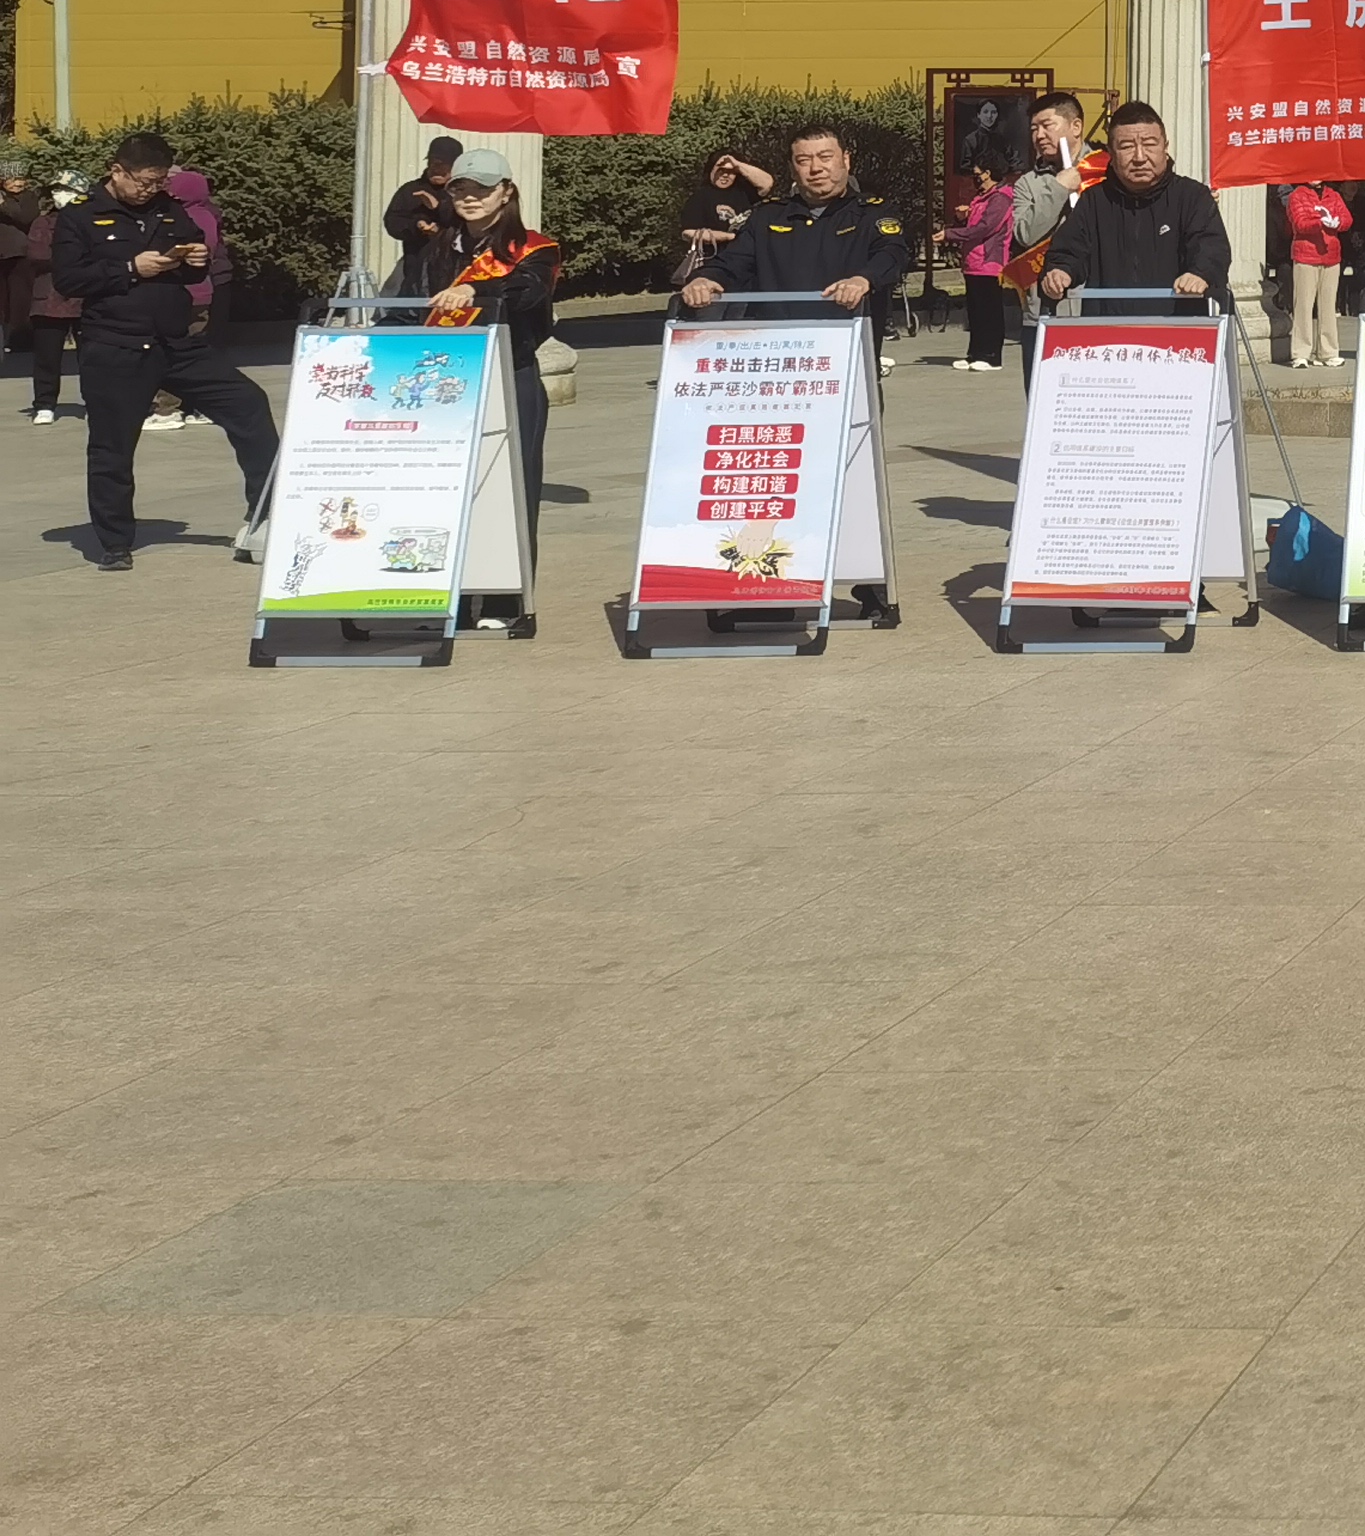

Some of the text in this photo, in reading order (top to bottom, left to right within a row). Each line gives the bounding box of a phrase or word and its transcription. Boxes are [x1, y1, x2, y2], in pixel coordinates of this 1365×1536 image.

[406, 35, 641, 79] 兴安盟自然资源局 宣
[400, 61, 611, 90] 乌兰浩特市自然资源局
[1053, 346, 1208, 364] 加强社会信用体系建设
[694, 356, 832, 374] 重拳出击扫黑除恶
[674, 379, 841, 398] 依法严惩沙霸矿霸犯罪
[718, 426, 794, 445] 扫黑除恶
[715, 450, 790, 469] 净化社会
[712, 475, 788, 494] 构建和谐
[710, 499, 784, 519] 创建平安
